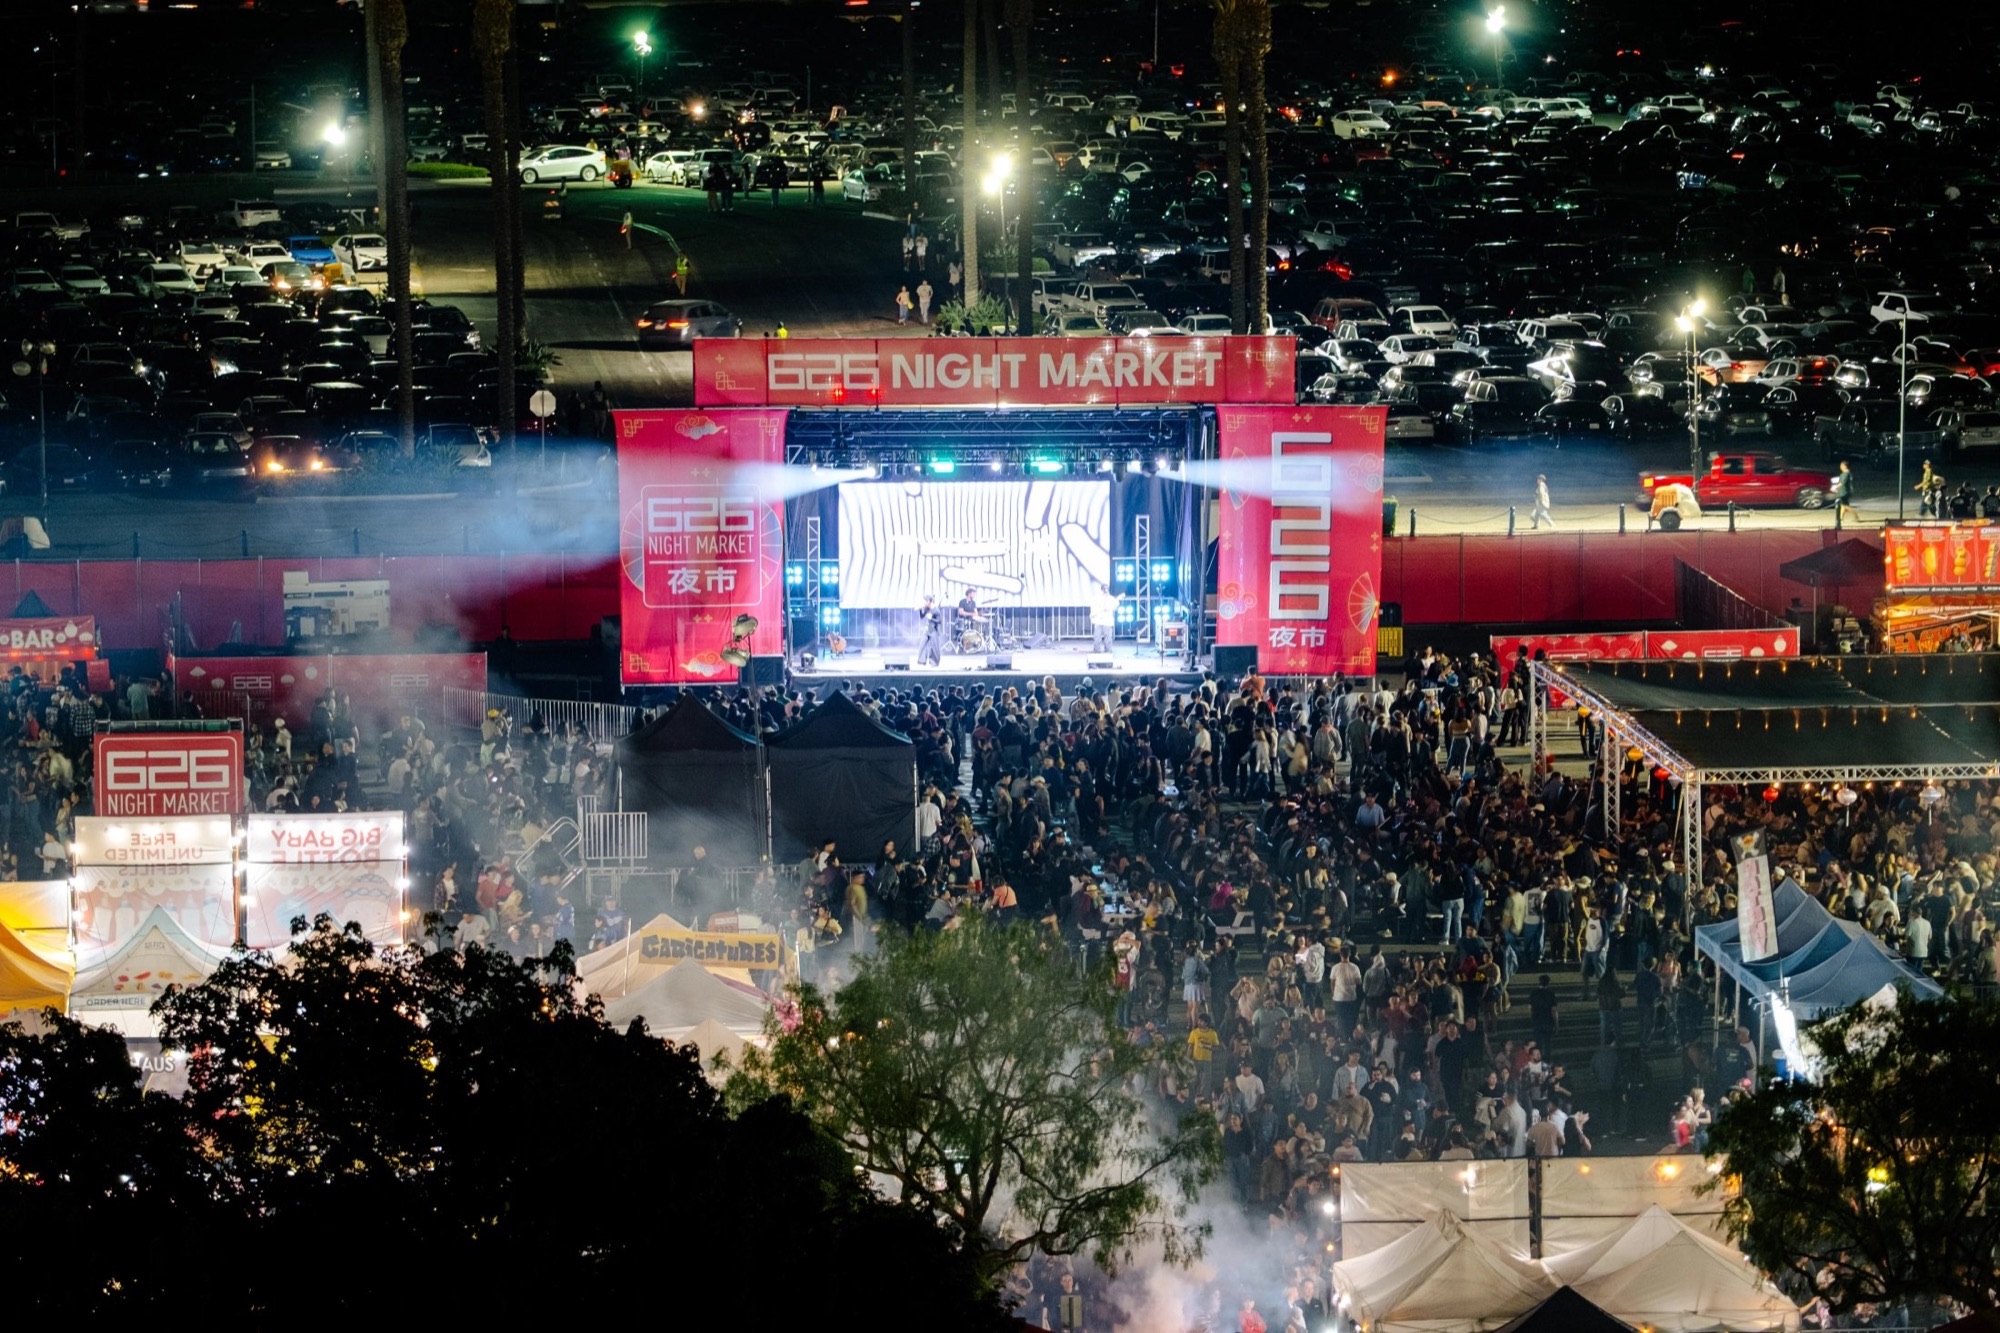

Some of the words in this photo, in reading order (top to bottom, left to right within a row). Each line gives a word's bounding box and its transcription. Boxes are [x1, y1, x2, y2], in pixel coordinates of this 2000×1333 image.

[768, 353, 880, 391] 626
[892, 353, 1027, 389] NIGHT
[1039, 352, 1223, 388] MARKET
[647, 496, 754, 533] 626
[1269, 432, 1332, 620] 626
[648, 535, 691, 555] NIGHT
[696, 534, 755, 554] MARKET
[667, 566, 737, 594] 夜市
[11, 629, 55, 649] BAR
[1269, 626, 1327, 648] 夜市
[232, 675, 272, 690] 626
[106, 749, 230, 790] 626
[107, 793, 157, 815] NIGHT
[163, 792, 230, 814] MARKET
[86, 998, 118, 1007] ORDER
[121, 997, 146, 1006] HERE
